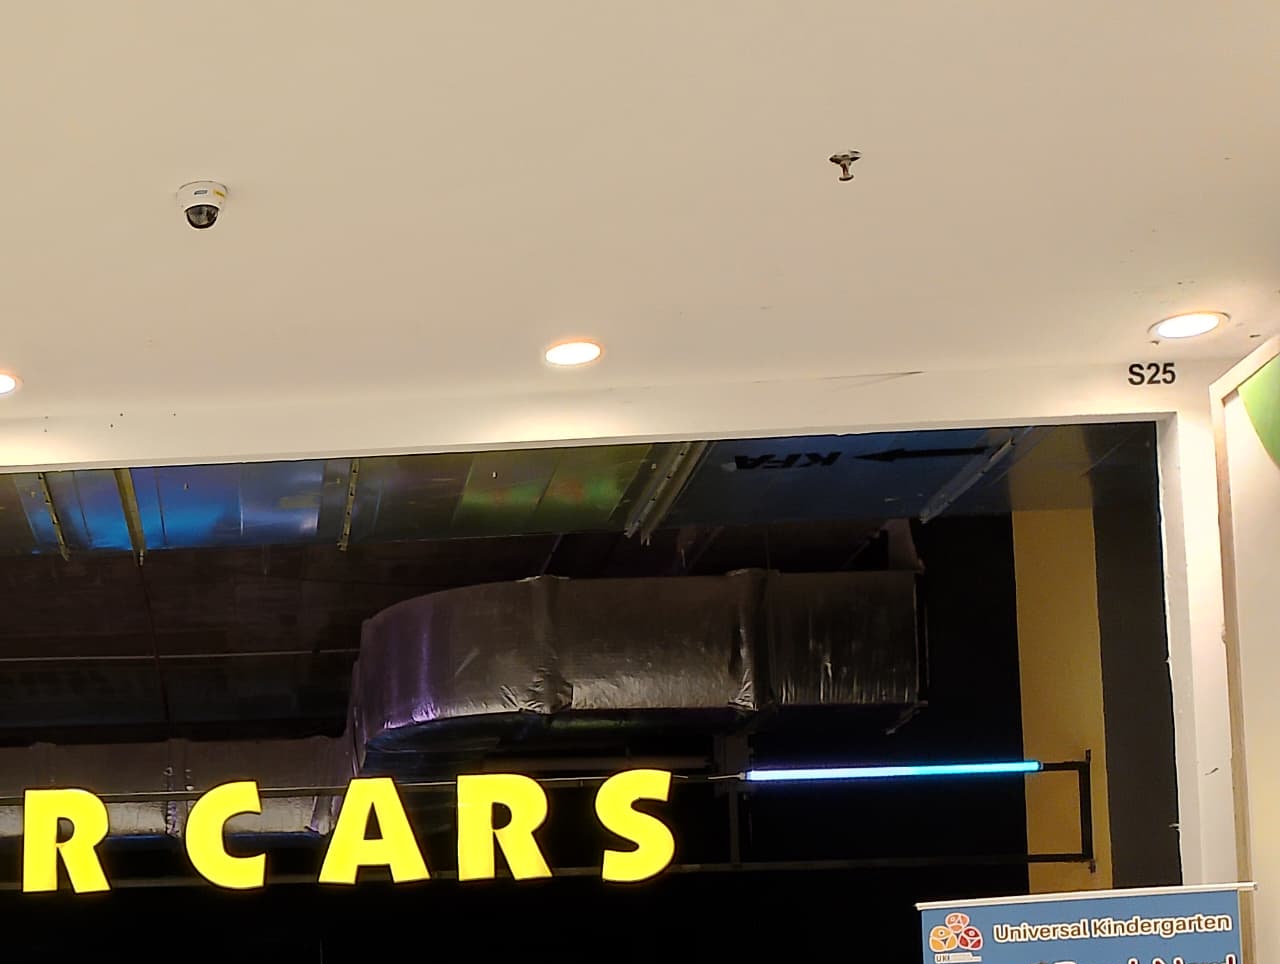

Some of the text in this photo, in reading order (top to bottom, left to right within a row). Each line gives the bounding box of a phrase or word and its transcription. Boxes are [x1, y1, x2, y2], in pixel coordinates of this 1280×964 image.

[1127, 362, 1176, 386] S25
[184, 768, 675, 890] CARS
[994, 914, 1232, 943] Universal Kindergarten
